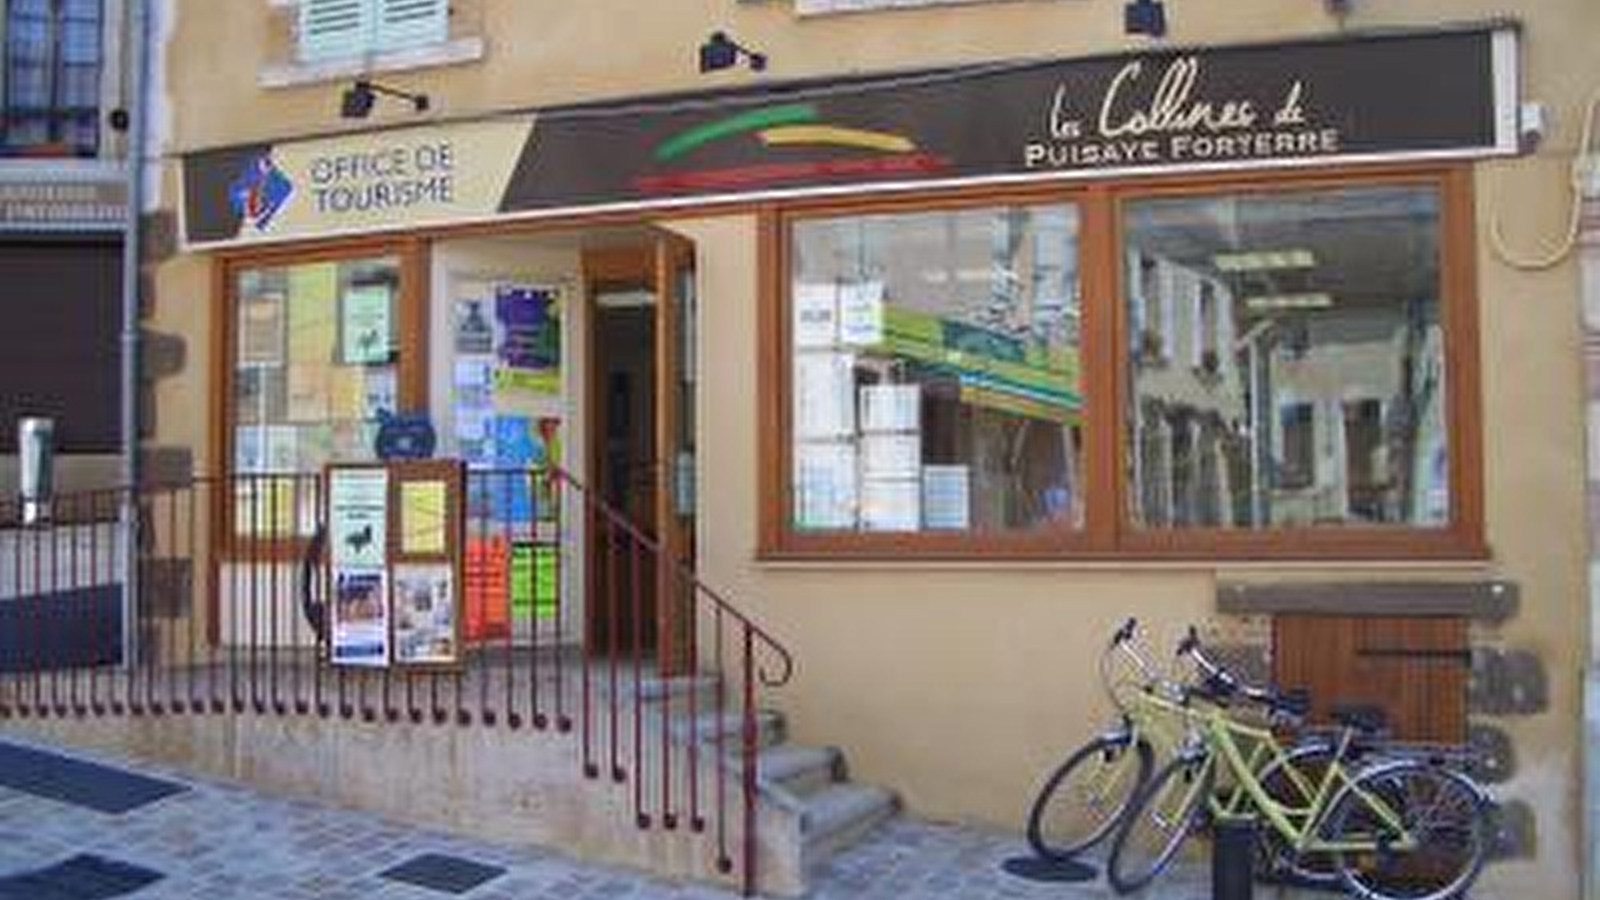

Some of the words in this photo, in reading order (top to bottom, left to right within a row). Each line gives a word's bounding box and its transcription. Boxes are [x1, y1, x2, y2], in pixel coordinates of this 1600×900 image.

[1099, 56, 1256, 138] Collines
[1274, 80, 1306, 126] de
[311, 147, 411, 184] OFFICE
[415, 143, 454, 171] DE
[313, 175, 454, 213] TOURISME
